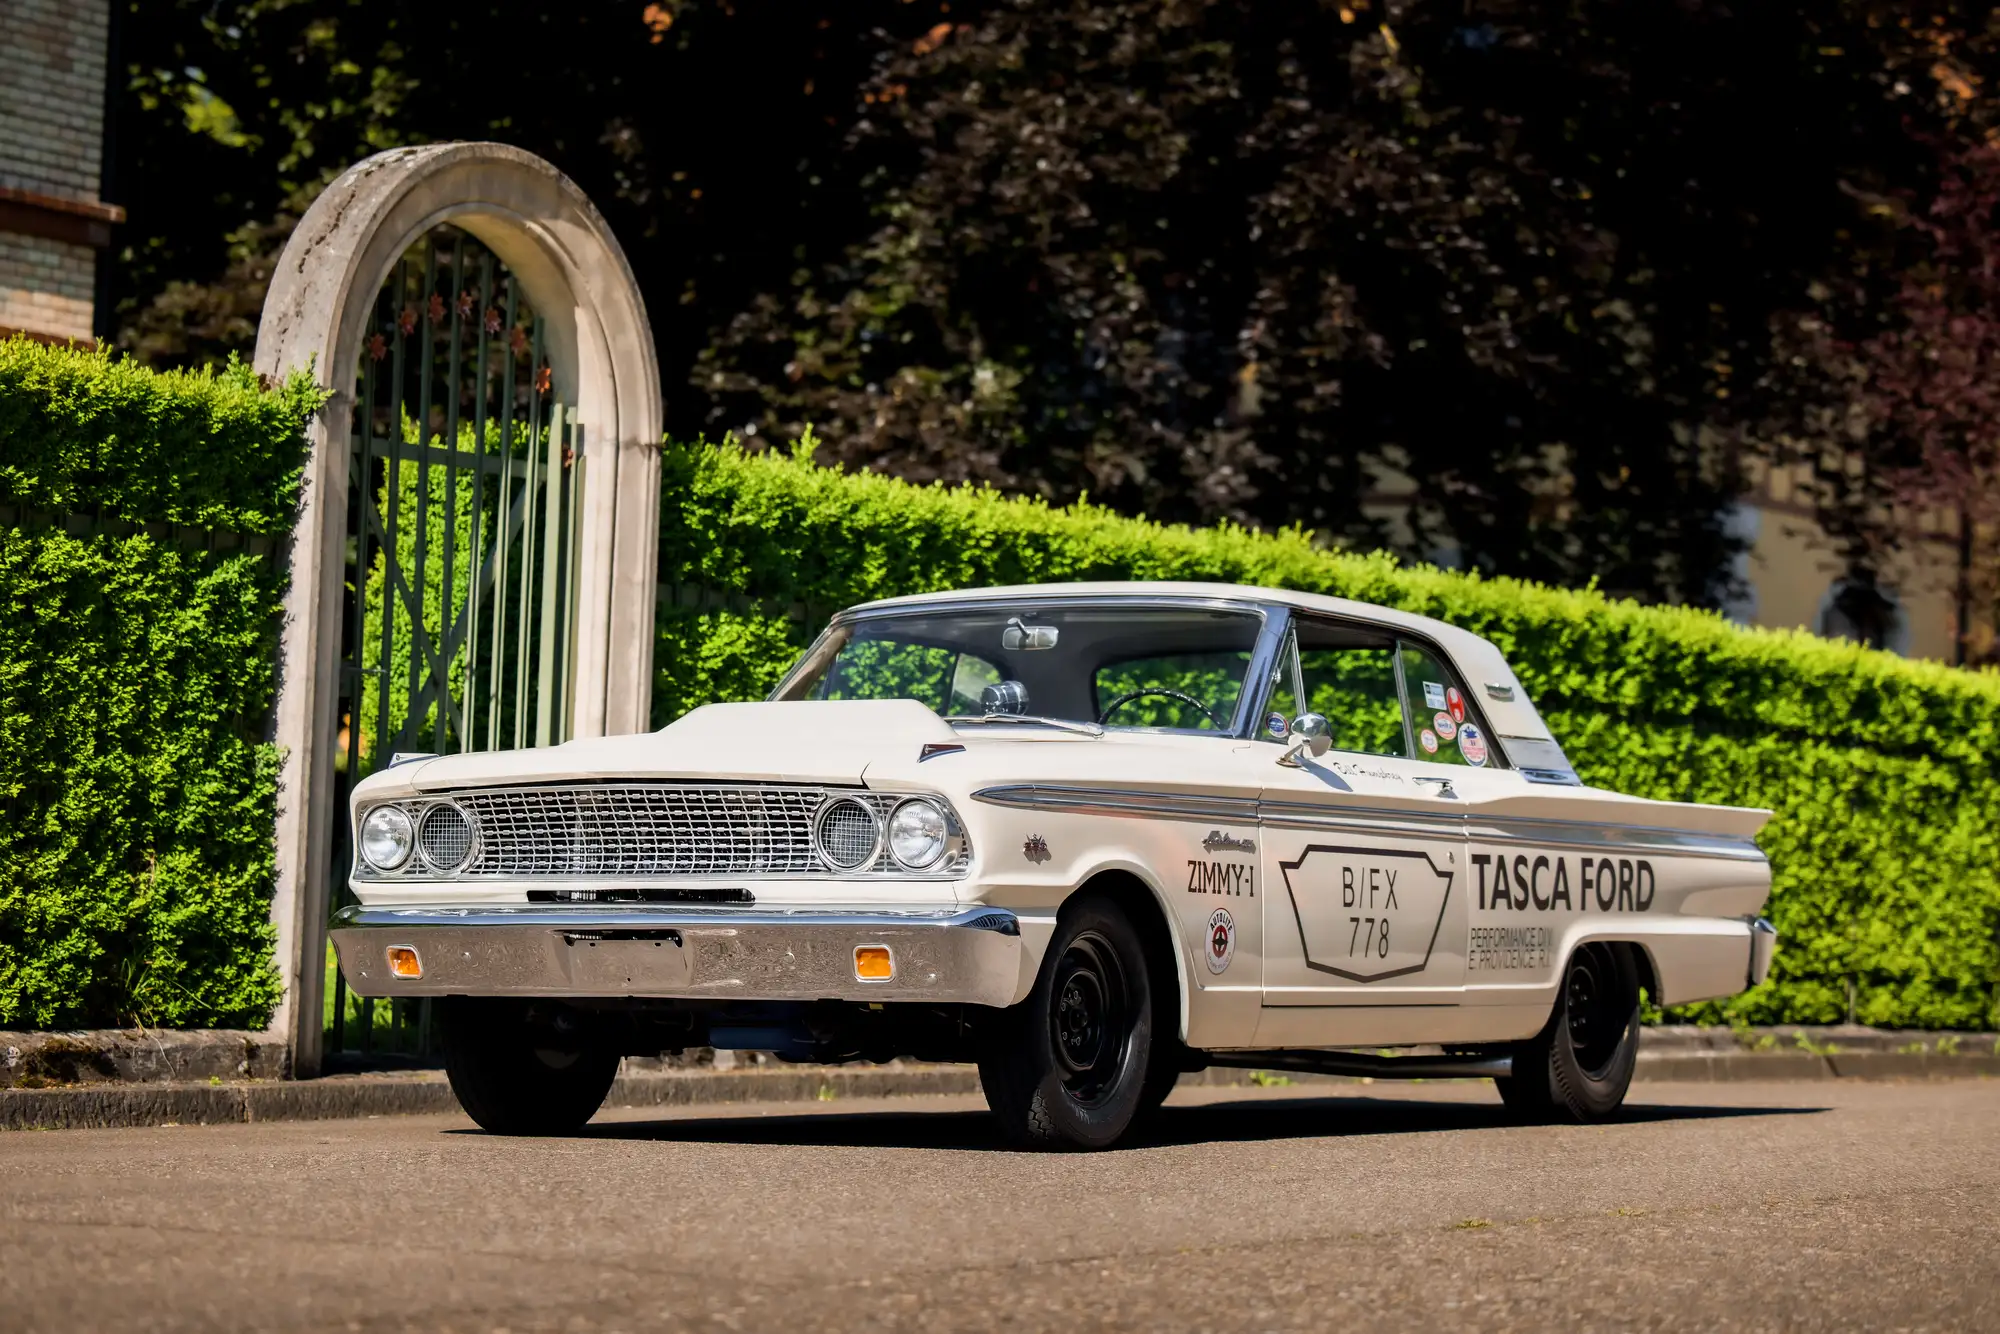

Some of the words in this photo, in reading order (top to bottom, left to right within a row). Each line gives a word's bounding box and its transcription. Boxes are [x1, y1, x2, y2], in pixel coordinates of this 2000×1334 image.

[1333, 762, 1357, 775] Bill
[1342, 866, 1398, 910] B/FX
[1471, 854, 1572, 911] TASCA
[1580, 857, 1655, 912] FORD
[1210, 912, 1233, 934] AUTOLITE
[1349, 917, 1389, 959] 778
[1470, 927, 1536, 948] PERFORMANCE
